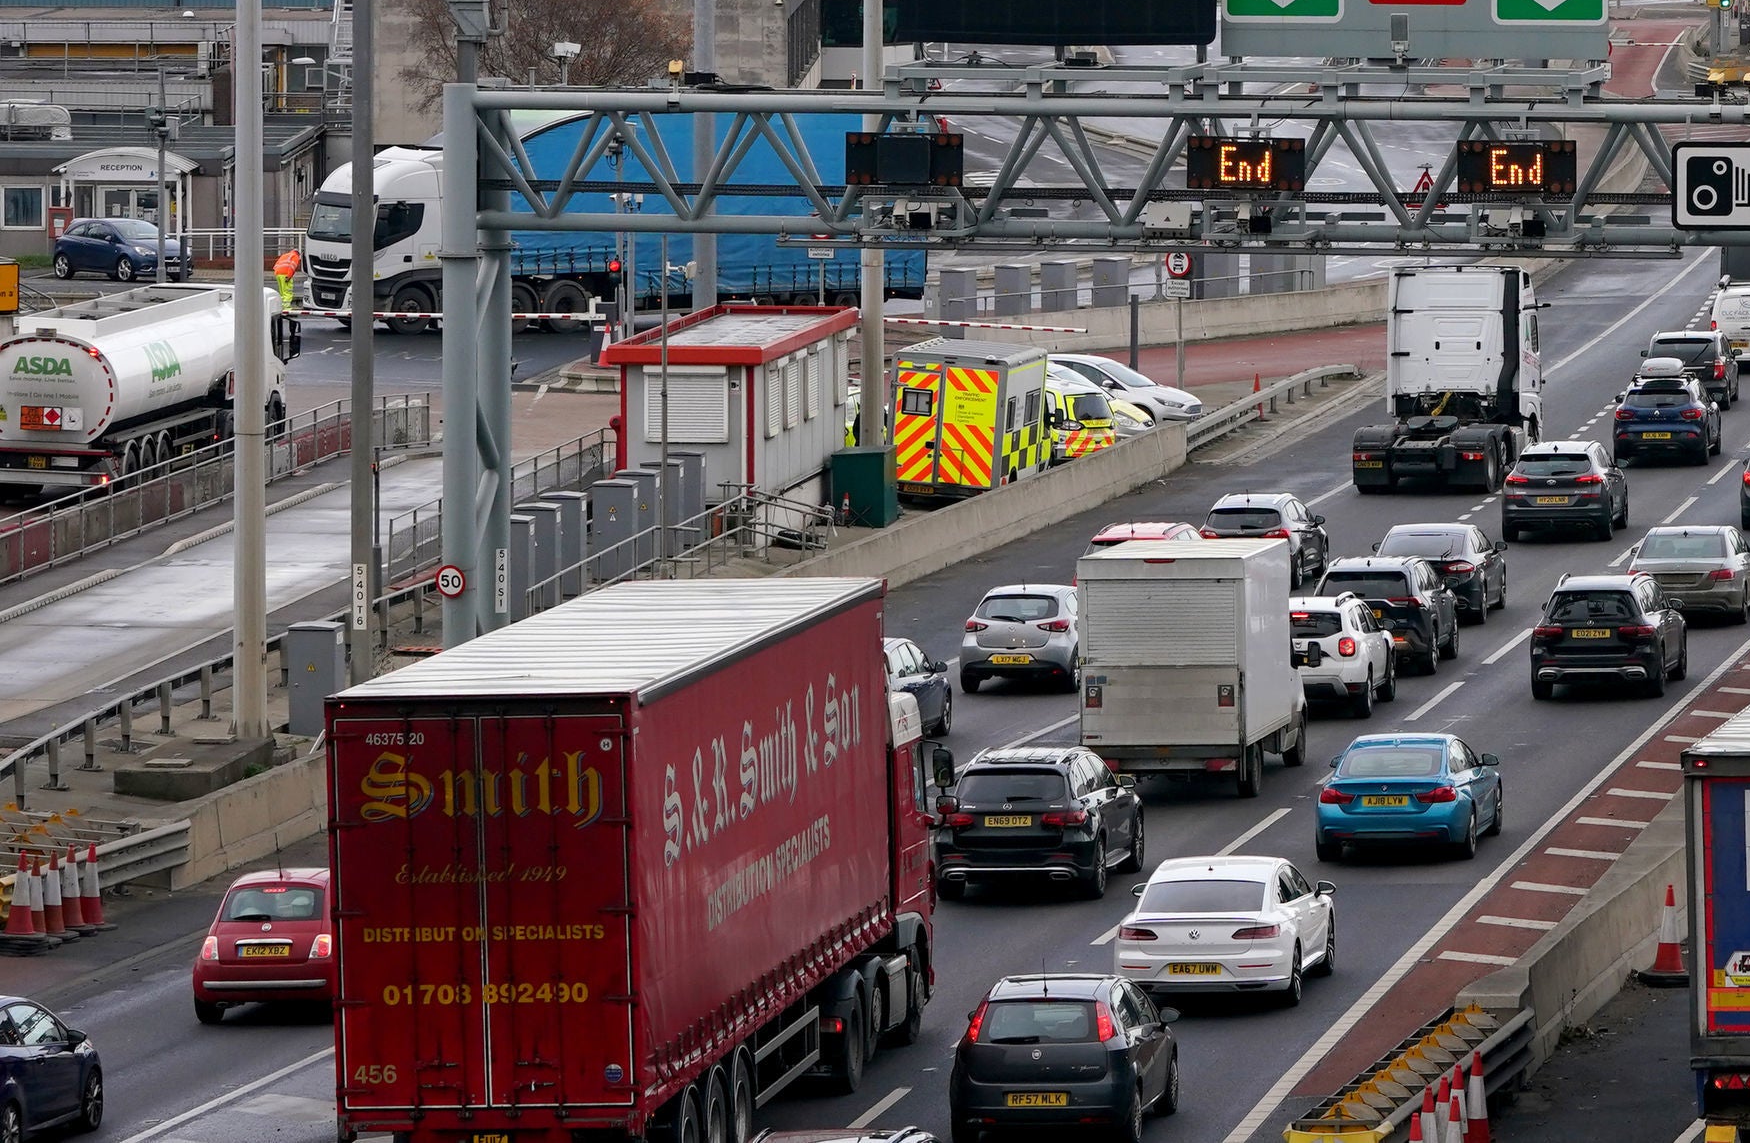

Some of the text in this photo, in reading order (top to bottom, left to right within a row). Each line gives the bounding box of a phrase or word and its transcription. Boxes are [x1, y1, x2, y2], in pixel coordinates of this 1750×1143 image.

[1221, 146, 1271, 181] End
[1491, 150, 1541, 184] End
[13, 356, 72, 376] ASDA
[440, 574, 462, 590] 50
[365, 732, 404, 746] 46375
[740, 698, 798, 807] Smith
[823, 672, 862, 770] Son
[360, 751, 605, 830] Smith
[1366, 797, 1386, 805] AJ18
[987, 816, 1010, 826] EN69
[395, 861, 567, 885] Established 1949
[707, 813, 831, 933] DISTRIBUTION SPECIALISTS
[492, 924, 605, 942] SPECIALISTS
[245, 945, 287, 956] EK12 XBZ
[1171, 963, 1219, 974] EA67 UWM
[383, 981, 589, 1006] 01708 892490
[354, 1064, 398, 1084] 456
[1009, 1093, 1062, 1105] RF57 MLK
